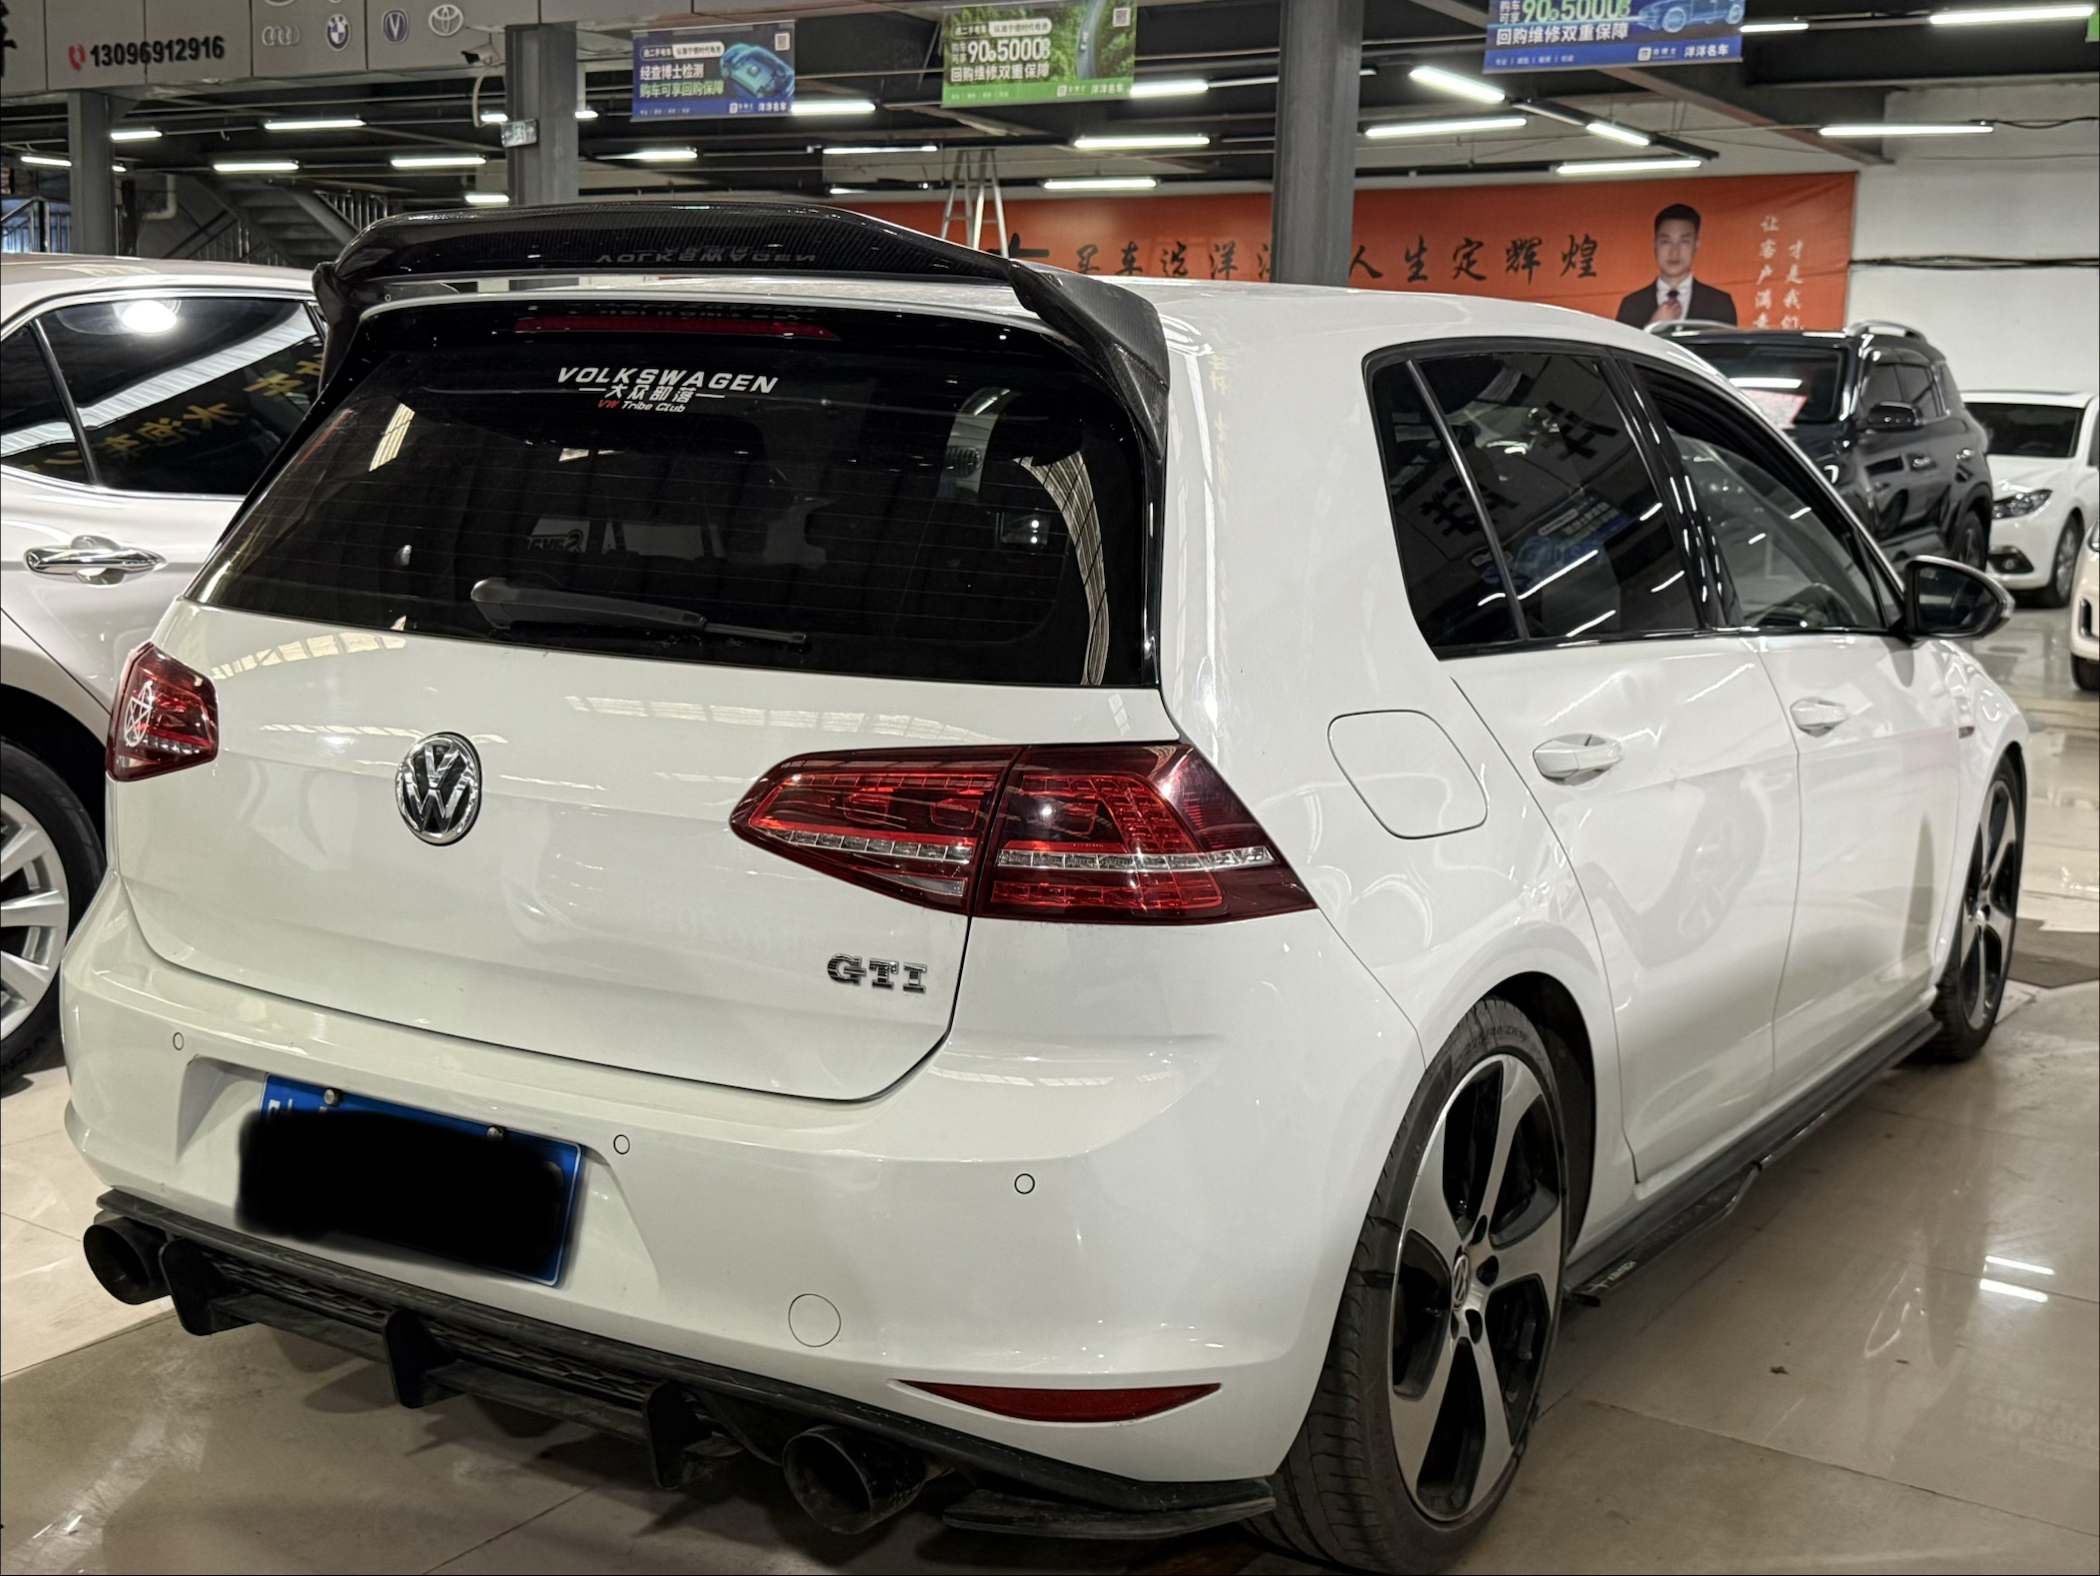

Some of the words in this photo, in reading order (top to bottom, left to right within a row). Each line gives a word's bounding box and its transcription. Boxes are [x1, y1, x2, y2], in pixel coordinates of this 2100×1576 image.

[1496, 22, 1630, 46] 回购维修双重保障
[90, 35, 225, 67] 13096912916
[951, 61, 1050, 82] 回购维修双重保障
[640, 80, 725, 98] 购车可享回购保障
[1349, 233, 1600, 285] 人生定辉煌
[558, 367, 779, 394] VOLKSWAGEN
[604, 383, 698, 403] 大众部落
[598, 399, 621, 409] VW
[621, 401, 654, 411] Tribe
[654, 403, 686, 413] Club
[827, 953, 928, 994] GTI
